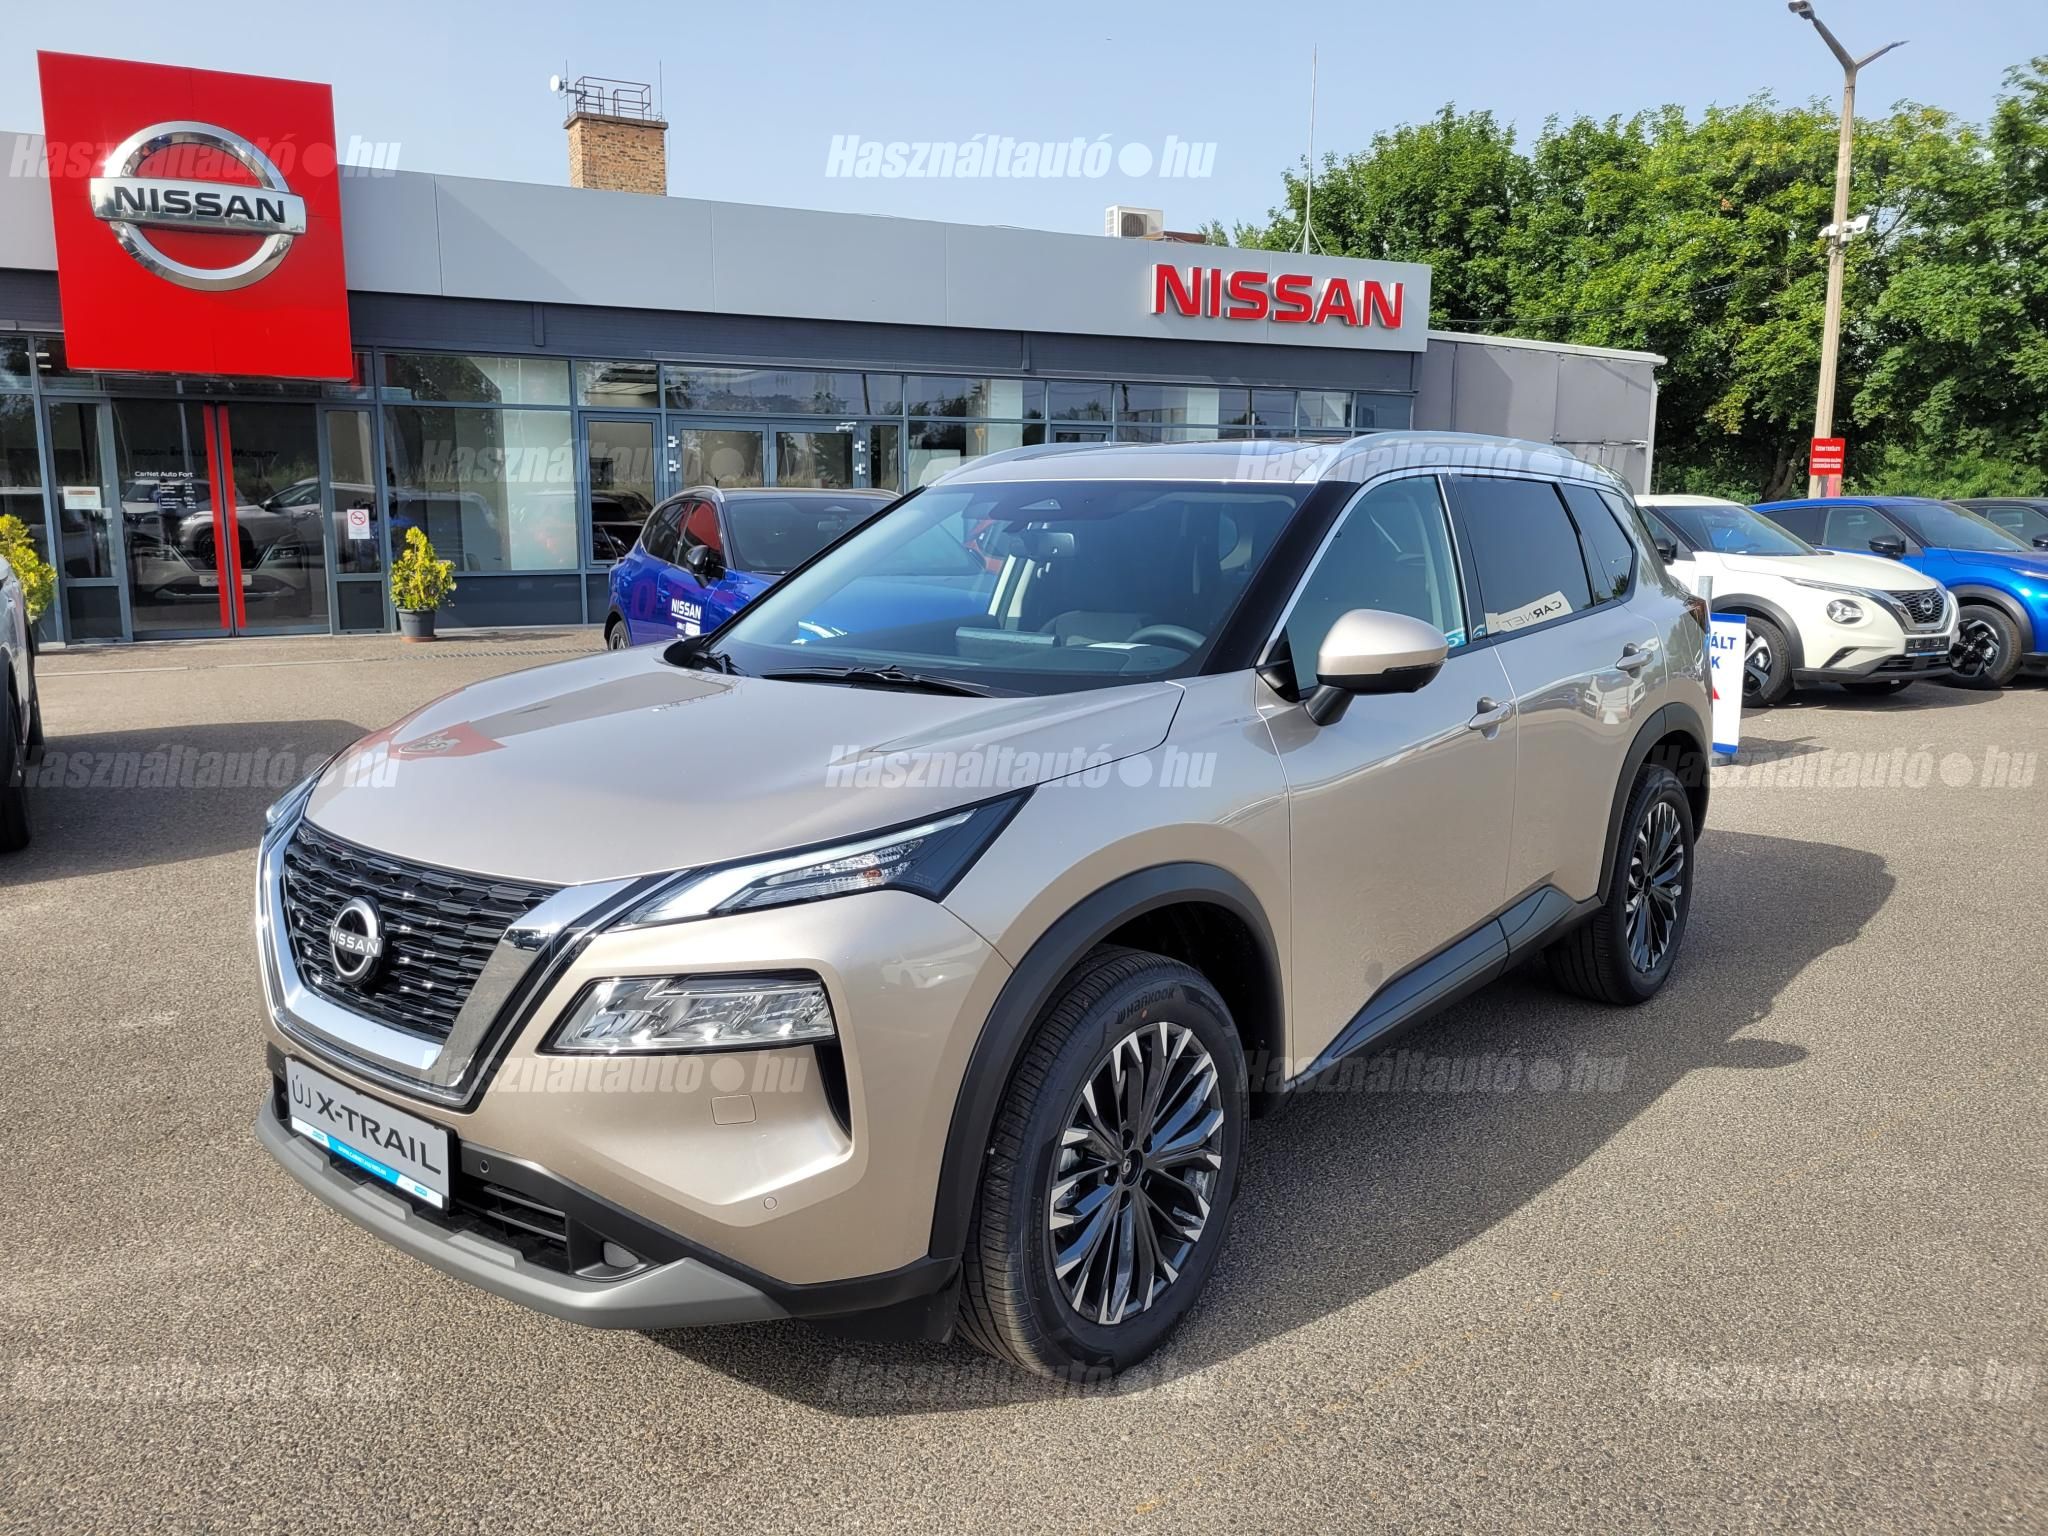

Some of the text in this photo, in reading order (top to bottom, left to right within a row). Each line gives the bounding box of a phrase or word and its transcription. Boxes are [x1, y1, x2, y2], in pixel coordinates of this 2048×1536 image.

[114, 185, 285, 224] NISSAN
[1151, 263, 1405, 329] NISSAN
[671, 598, 701, 619] NISSAN
[1710, 632, 1737, 650] ÁLT
[329, 926, 379, 955] NISSAN
[291, 1074, 312, 1109] ÚJ
[316, 1091, 442, 1176] X-TRAIL
